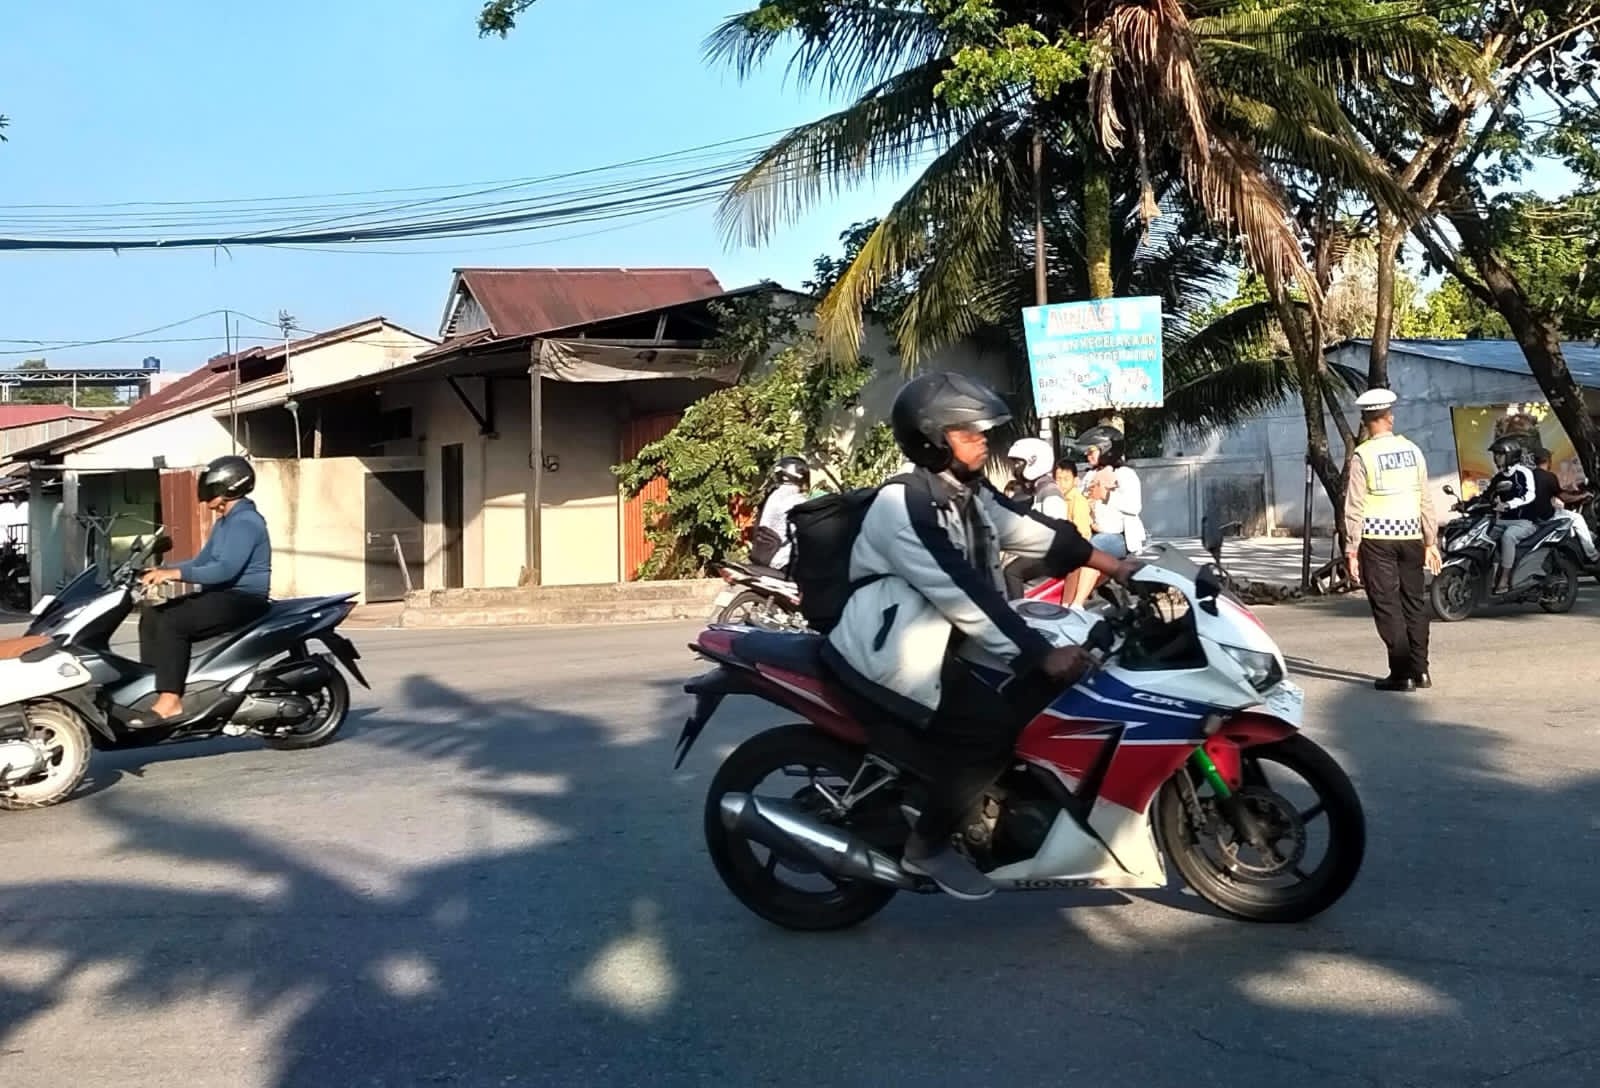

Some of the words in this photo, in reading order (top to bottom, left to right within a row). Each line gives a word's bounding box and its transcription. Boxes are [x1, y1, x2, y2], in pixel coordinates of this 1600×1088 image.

[1379, 451, 1415, 469] POLISI
[1131, 692, 1188, 709] CBR
[1013, 879, 1108, 888] HONDA
